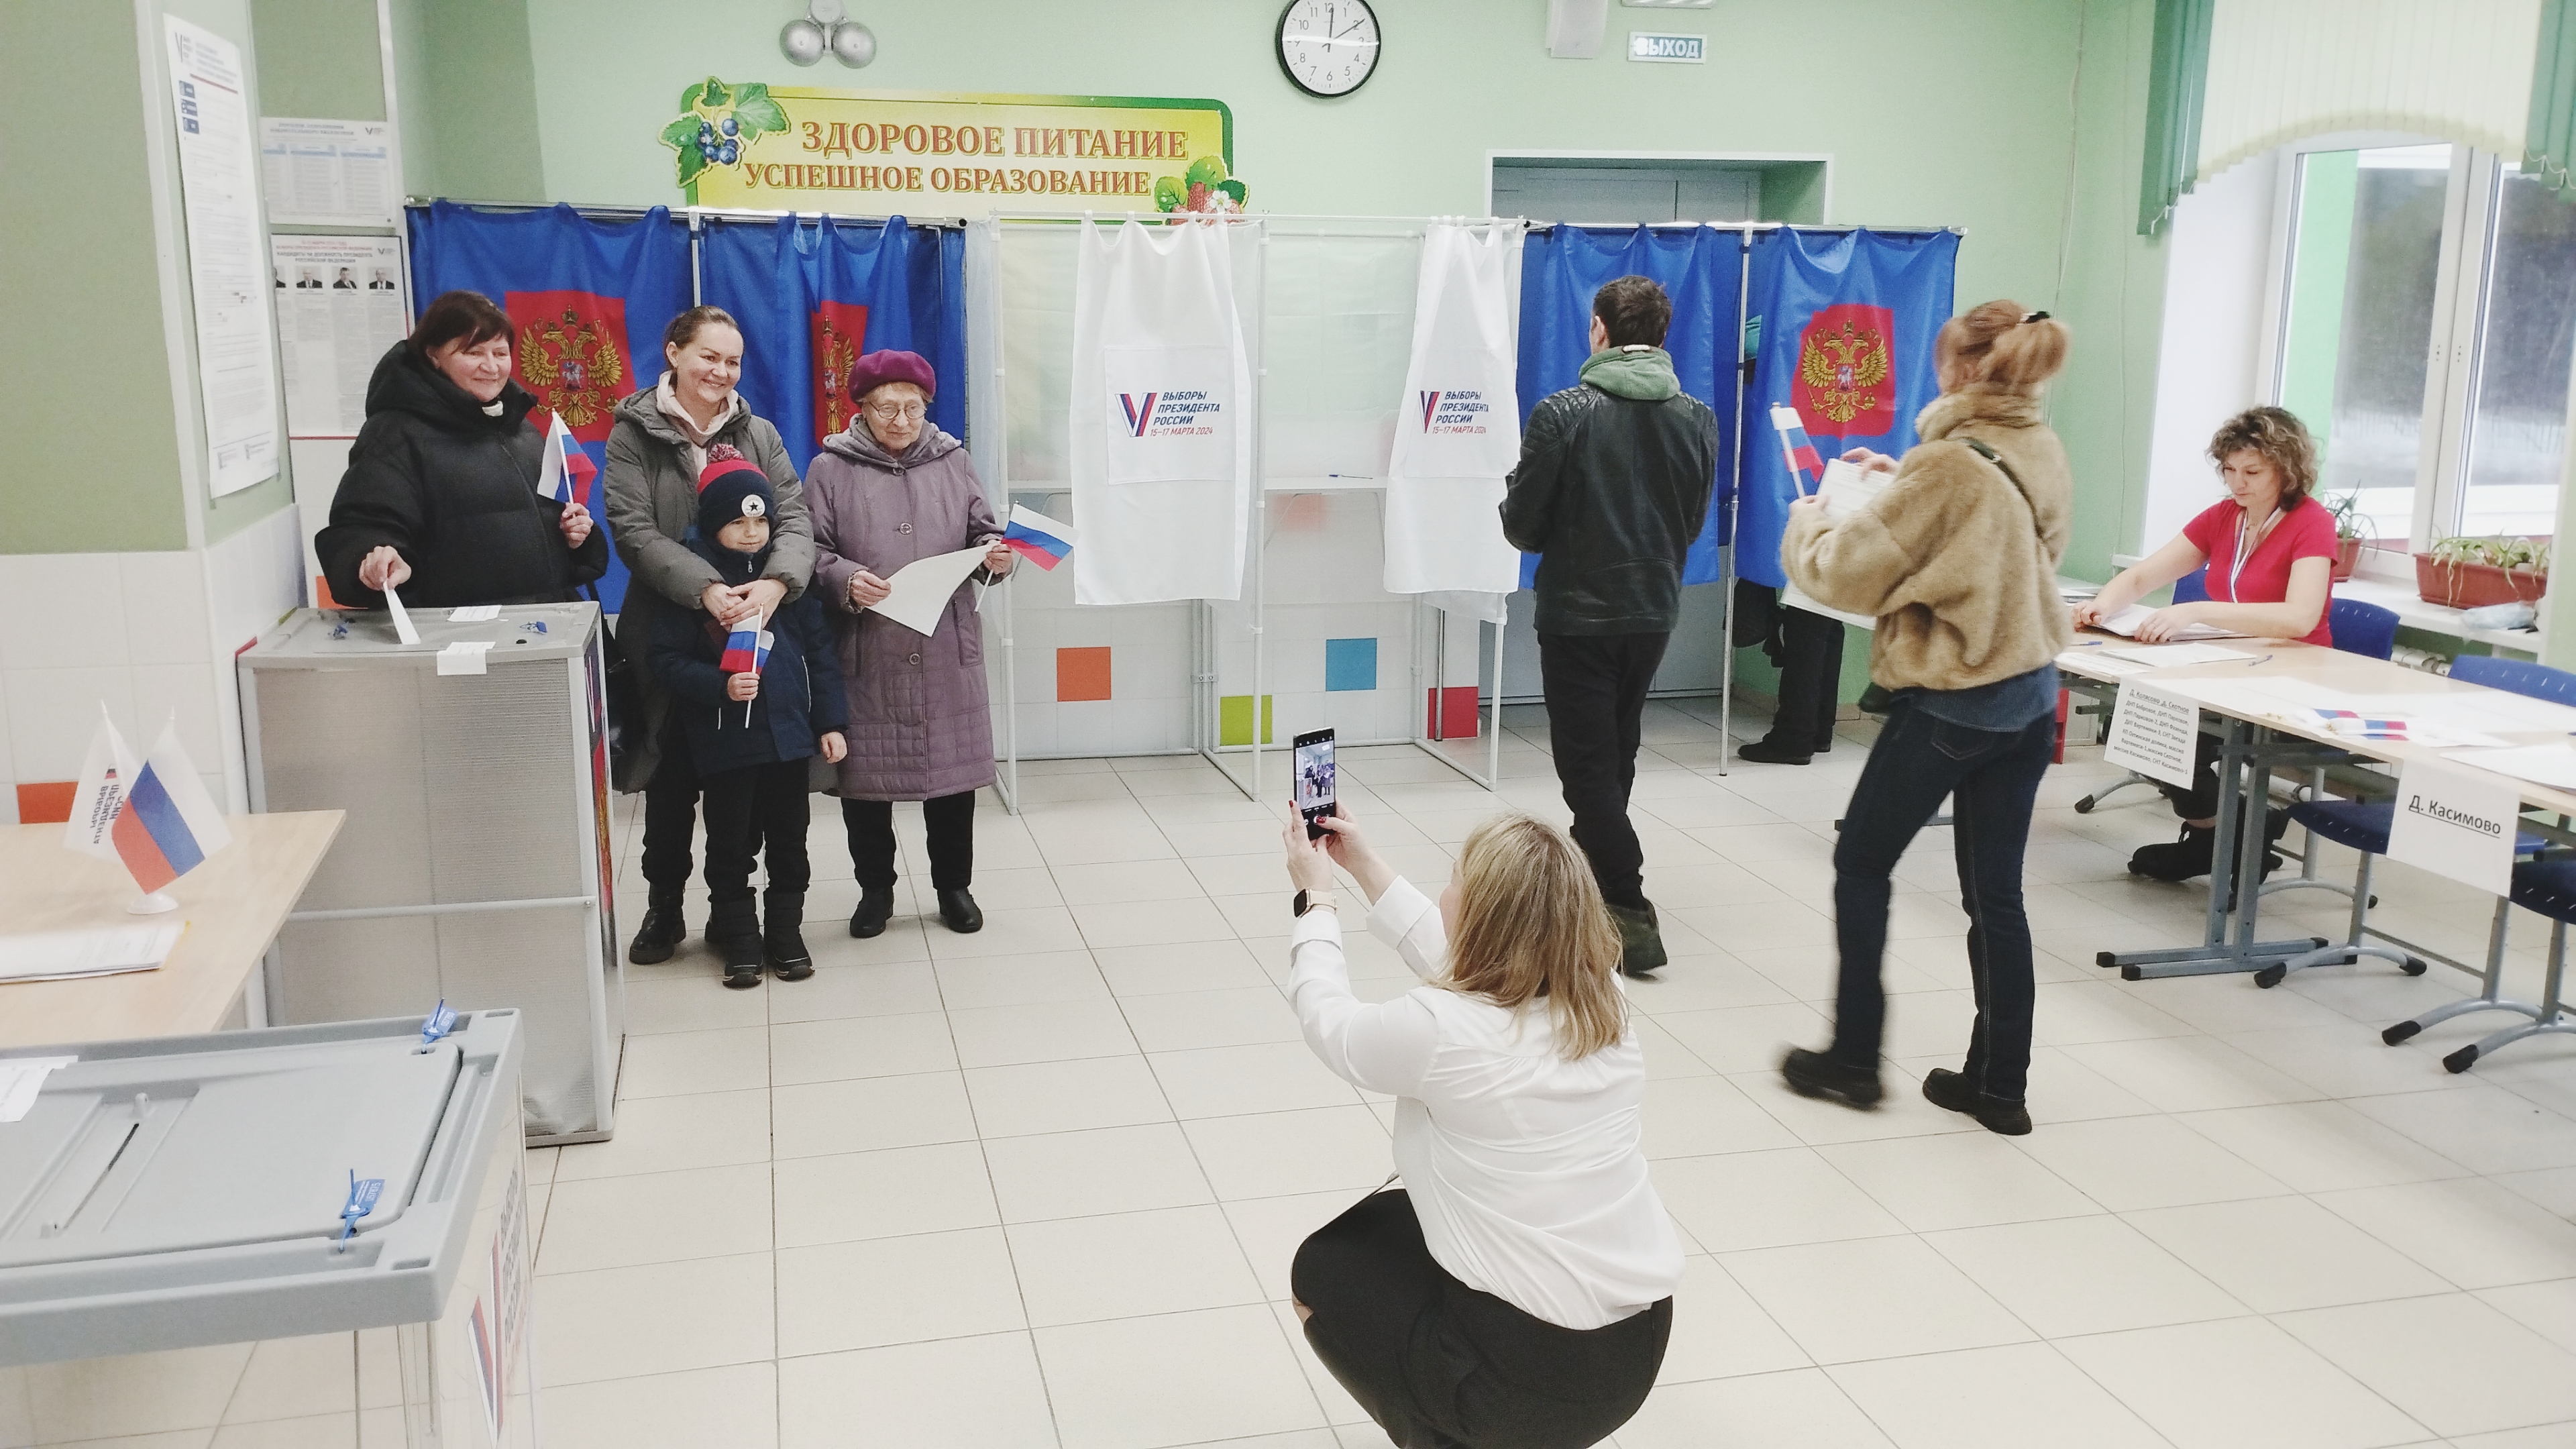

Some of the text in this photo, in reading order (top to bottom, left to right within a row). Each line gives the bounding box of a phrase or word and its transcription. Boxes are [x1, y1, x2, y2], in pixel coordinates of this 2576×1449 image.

[1310, 7, 1318, 17] 11
[1299, 19, 1309, 30] 10
[1299, 53, 1306, 62] 8
[1354, 53, 1360, 62] 4
[1310, 66, 1317, 76] 7
[1326, 71, 1333, 81] 6
[1344, 66, 1350, 76] 5
[802, 121, 1188, 160] ЗДОРОВОЕ ПИТАНИЕ
[744, 162, 1150, 195] УСПЕШНОЕ ОБРАЗОВАНИЕ
[1162, 391, 1208, 401] ВЫБОРЫ
[1444, 391, 1482, 400] ВЫБОРЫ
[1157, 403, 1220, 414] ПРЕЗИДЕНТА
[1440, 402, 1489, 413] ПРЕЗИДЕНТА
[1153, 416, 1193, 426] РОССИИ
[1436, 415, 1472, 424] РОССИИ
[1171, 427, 1194, 436] МАРТА
[1196, 427, 1213, 435] 2024
[1451, 426, 1473, 434] МАРТА
[2409, 795, 2501, 835] Д. Касимово
